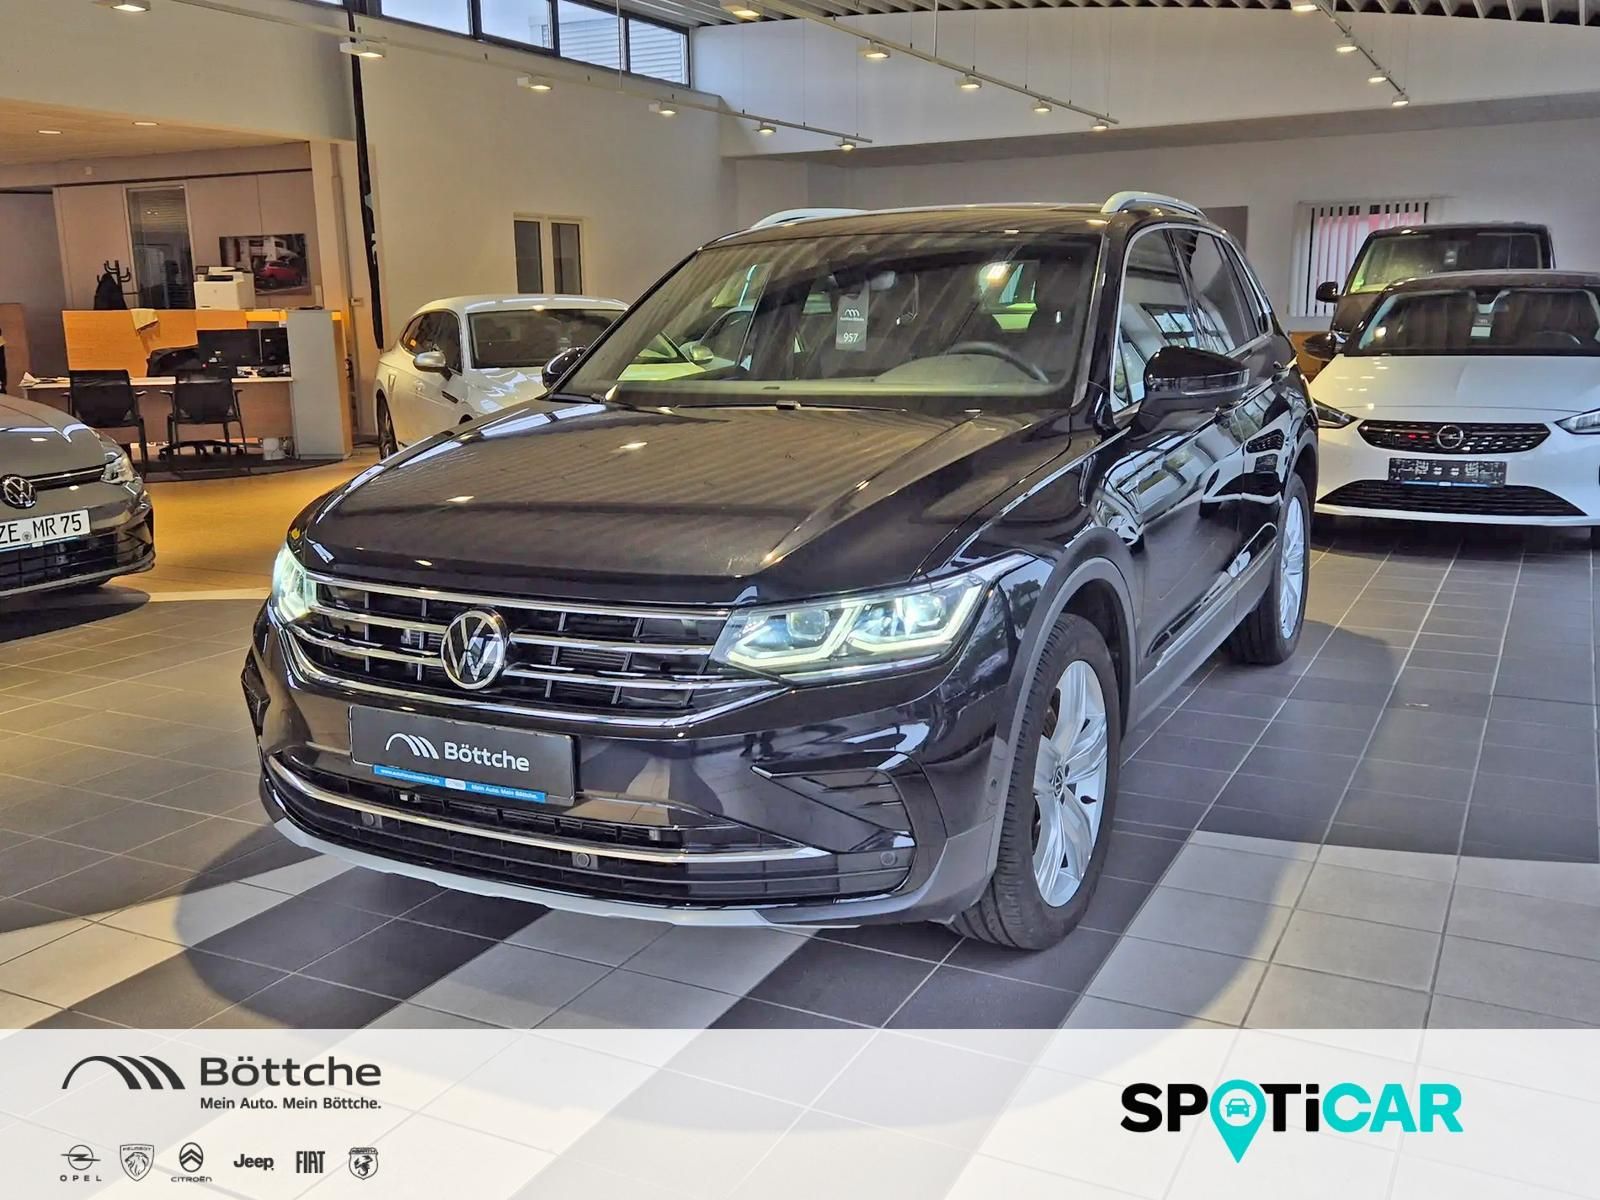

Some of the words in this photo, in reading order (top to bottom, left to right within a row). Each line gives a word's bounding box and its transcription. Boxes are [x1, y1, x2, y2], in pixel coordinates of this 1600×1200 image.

[843, 332, 859, 343] 957
[33, 518, 57, 538] MR
[60, 514, 82, 534] 75
[444, 742, 530, 772] Böttche
